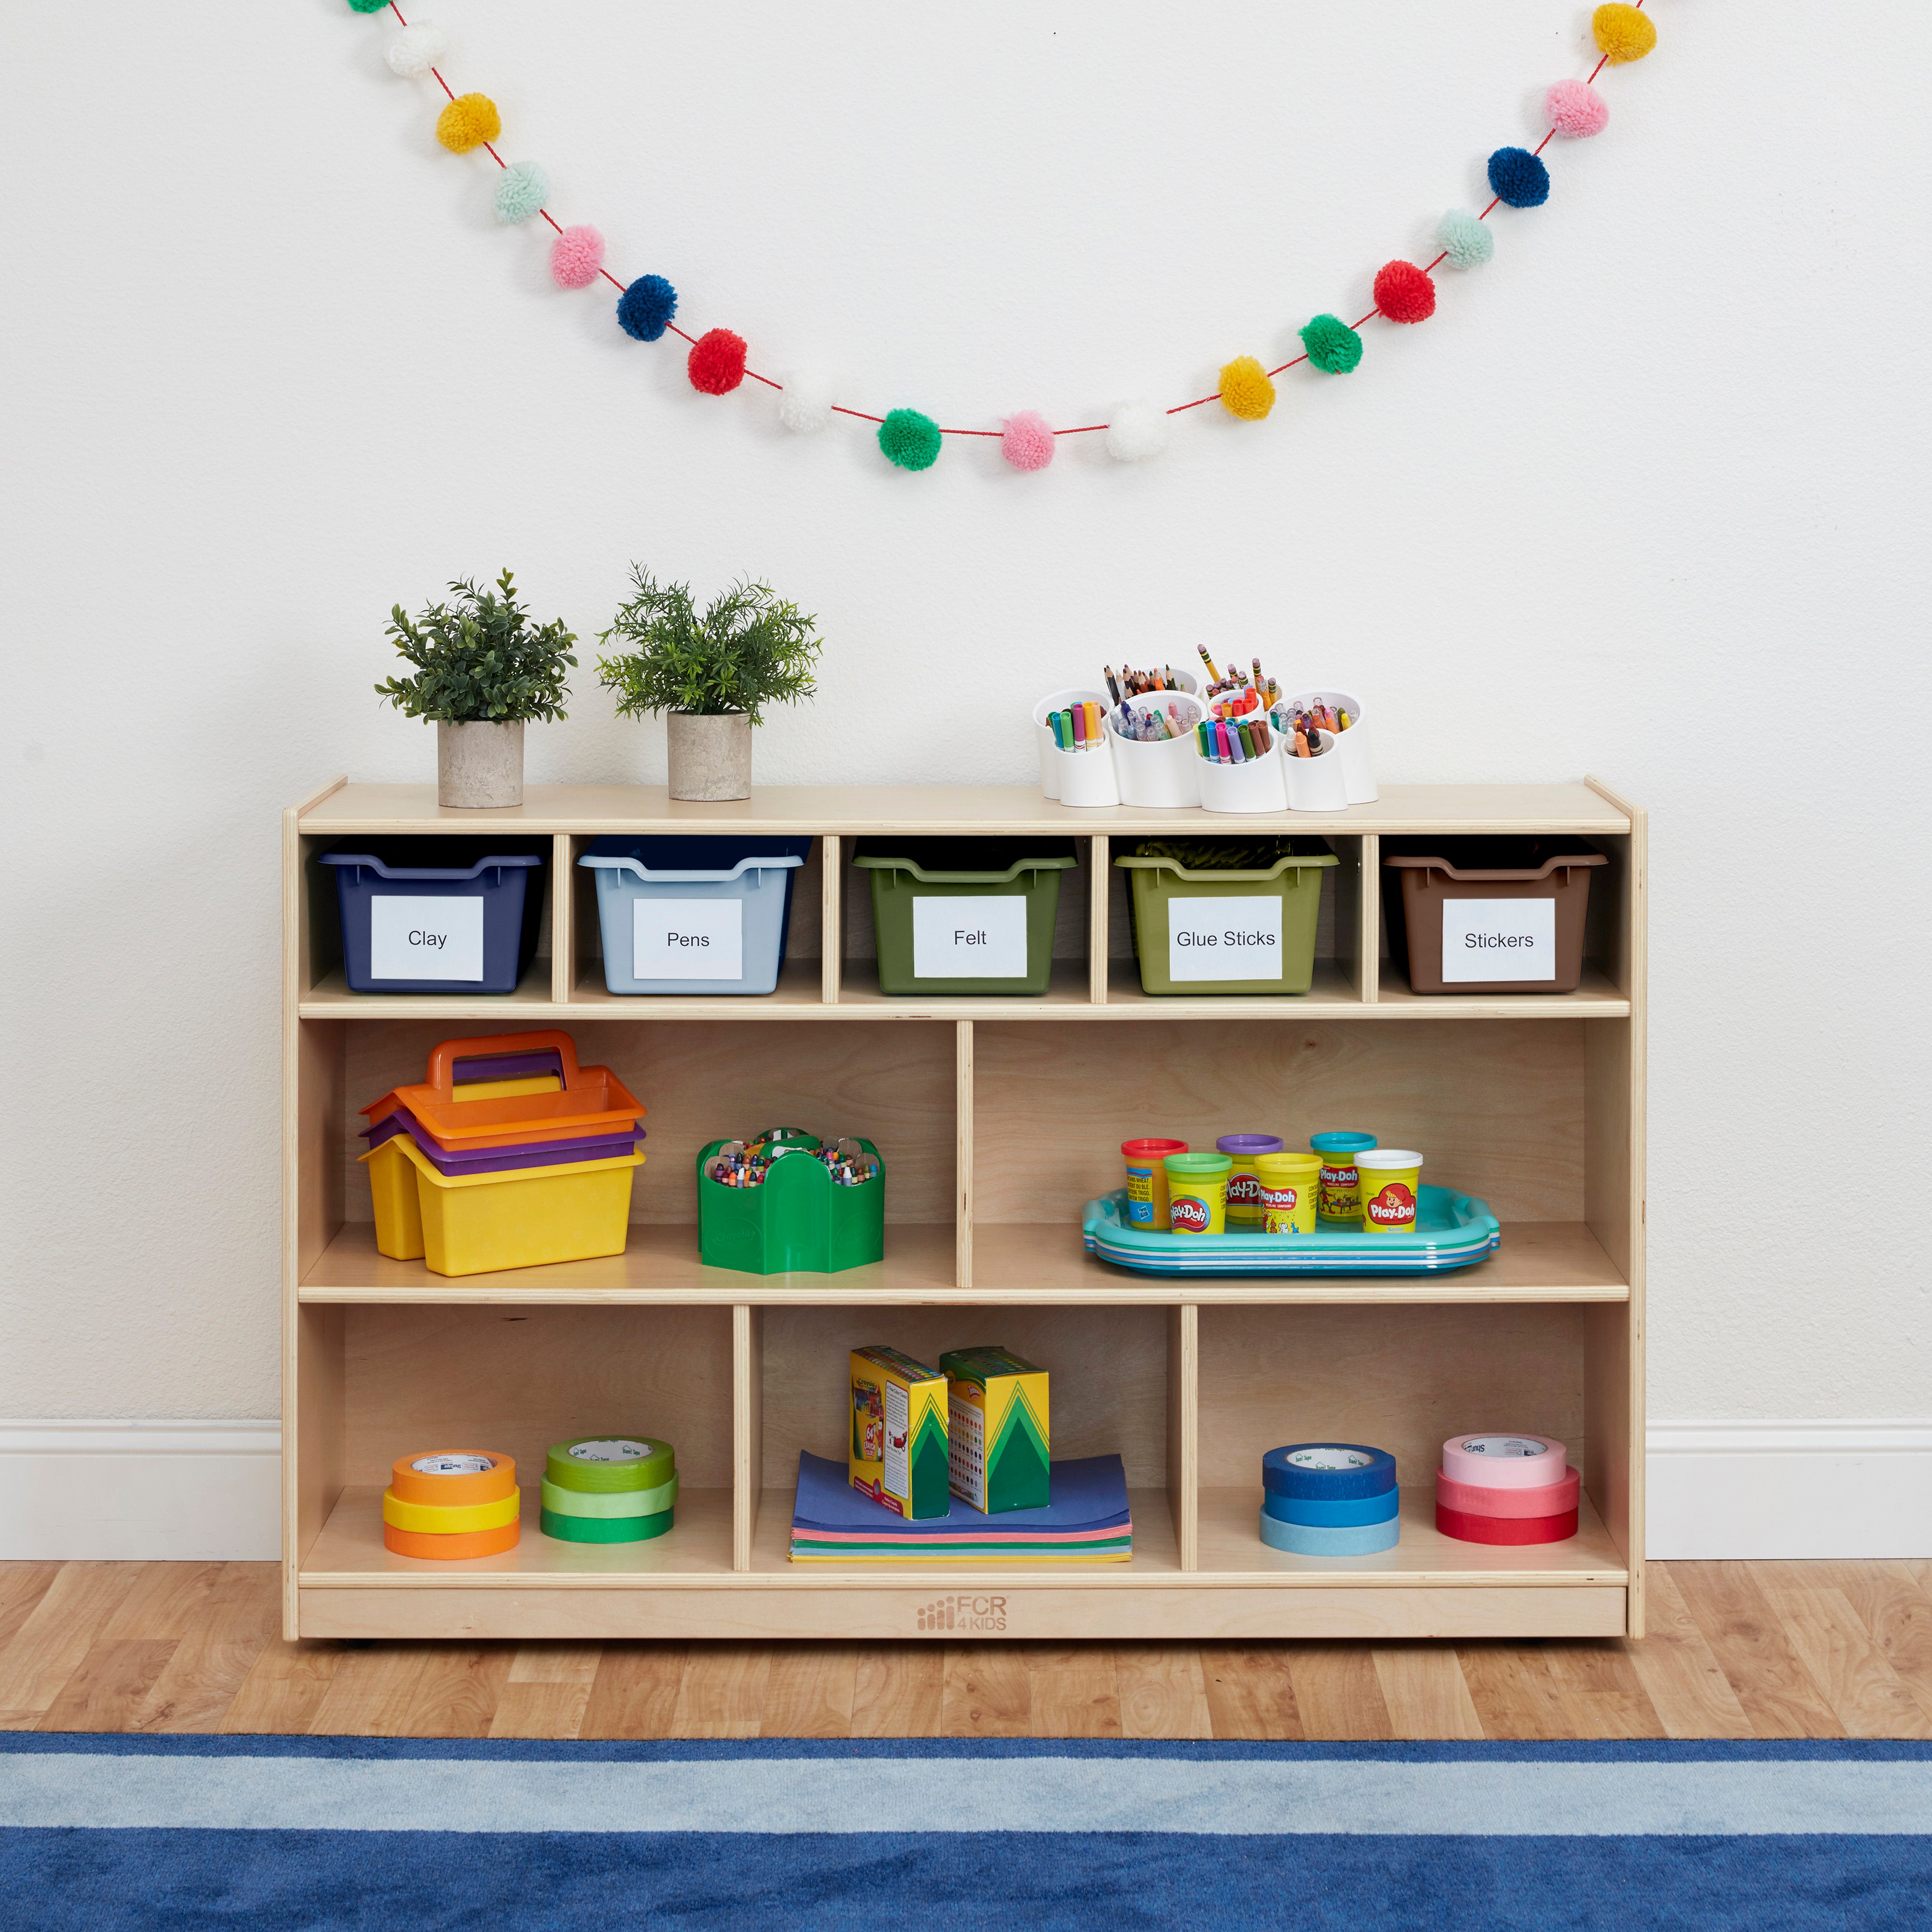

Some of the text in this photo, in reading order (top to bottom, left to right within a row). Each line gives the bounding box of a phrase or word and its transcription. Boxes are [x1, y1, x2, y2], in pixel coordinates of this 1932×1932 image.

[409, 931, 447, 949] Clay
[668, 933, 709, 946] Pens
[955, 930, 986, 945] Felt
[1178, 931, 1275, 946] Glue Sticks
[1465, 933, 1533, 948] Stickers
[1320, 1169, 1358, 1182] Play-Doh
[1226, 1180, 1260, 1200] lay-D
[1261, 1189, 1294, 1203] Play-Doh
[1170, 1205, 1206, 1224] Play-Doh
[1371, 1204, 1414, 1219] Play-Doh
[858, 1378, 875, 1387] Crayola
[867, 1427, 873, 1440] 64
[957, 1596, 1007, 1616] FCR
[957, 1617, 1007, 1631] 4 KIDS
